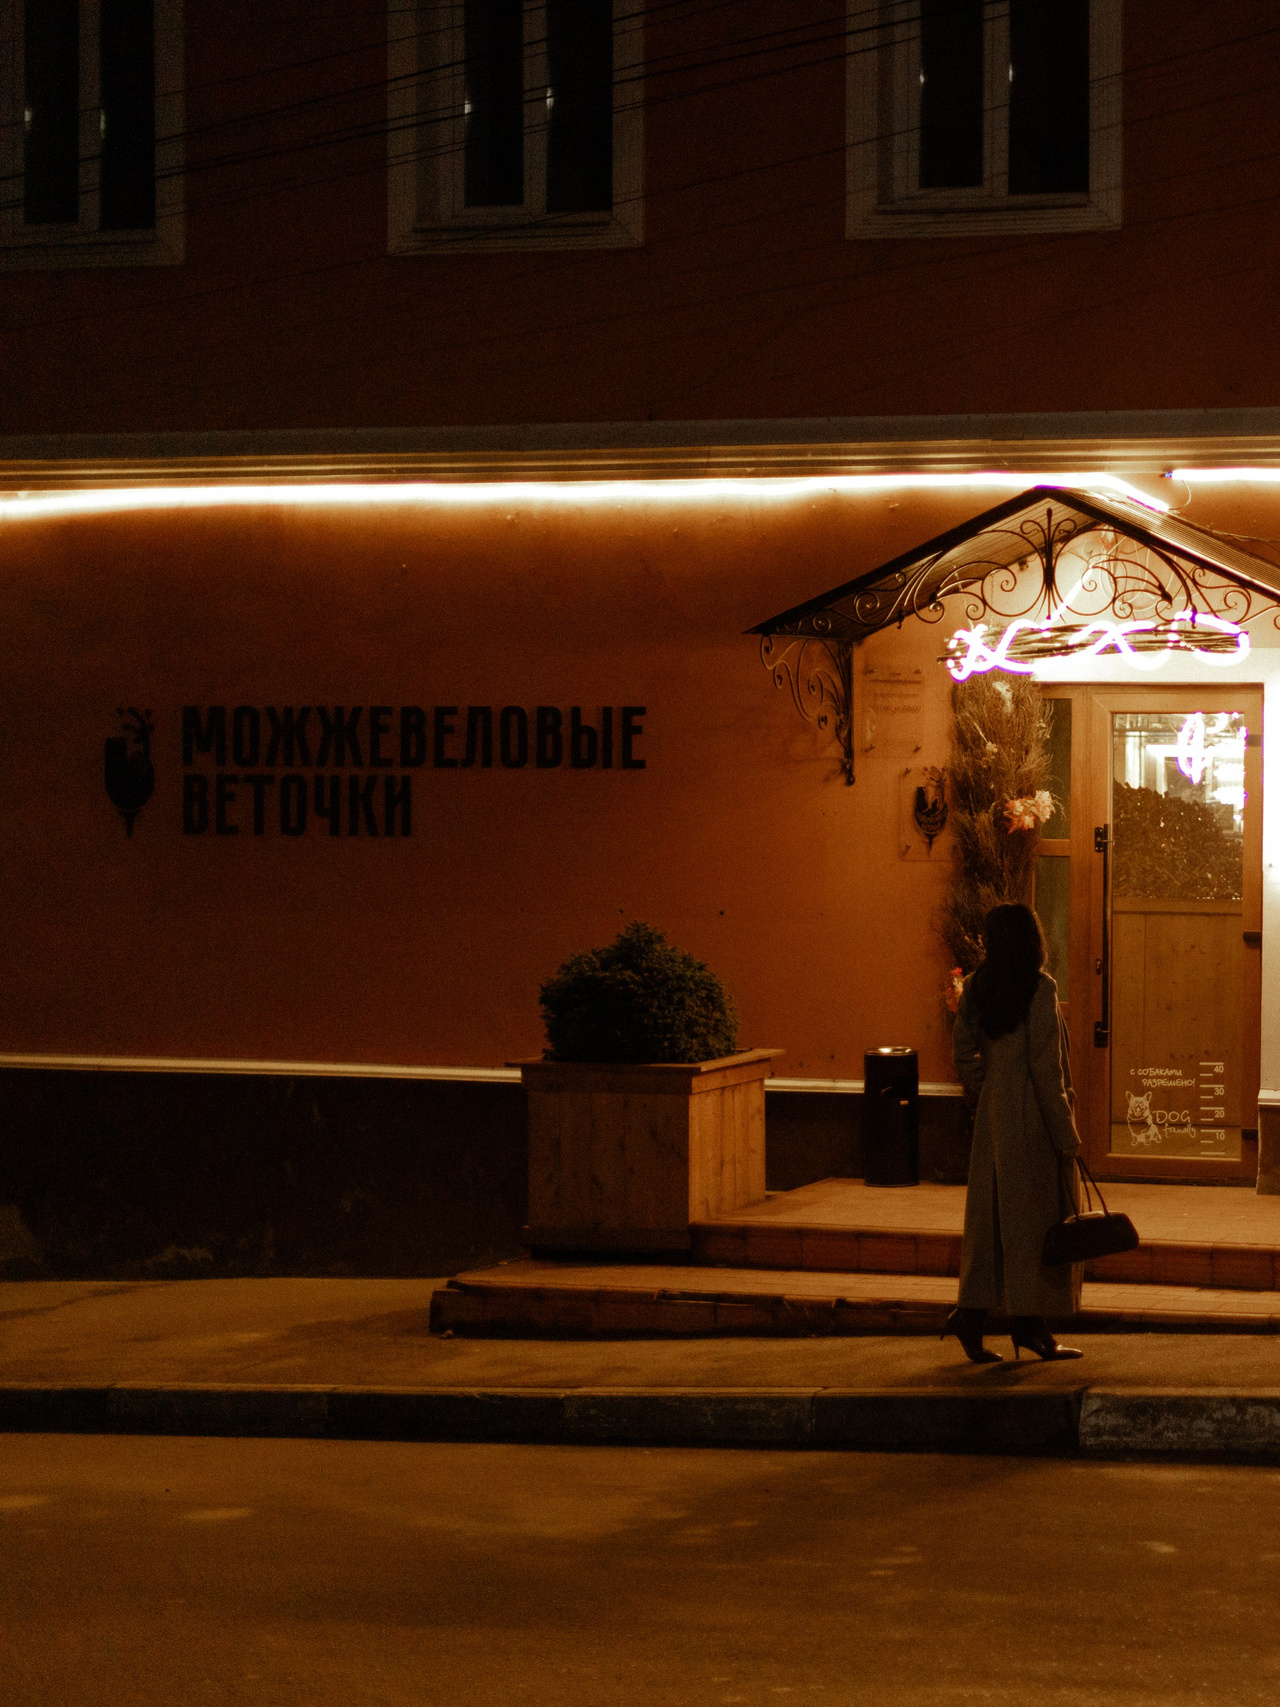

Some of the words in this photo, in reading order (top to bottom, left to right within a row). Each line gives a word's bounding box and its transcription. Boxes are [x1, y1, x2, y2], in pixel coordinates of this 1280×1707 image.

[182, 705, 646, 769] МОЖЖЕВЕЛОВЫЕ
[182, 773, 412, 837] ВЕТОЧКИ
[1213, 1065, 1224, 1073] 40
[1214, 1087, 1224, 1096] 30
[1152, 1110, 1191, 1123] DOG
[1214, 1110, 1225, 1118] 20
[1215, 1132, 1225, 1140] 10
